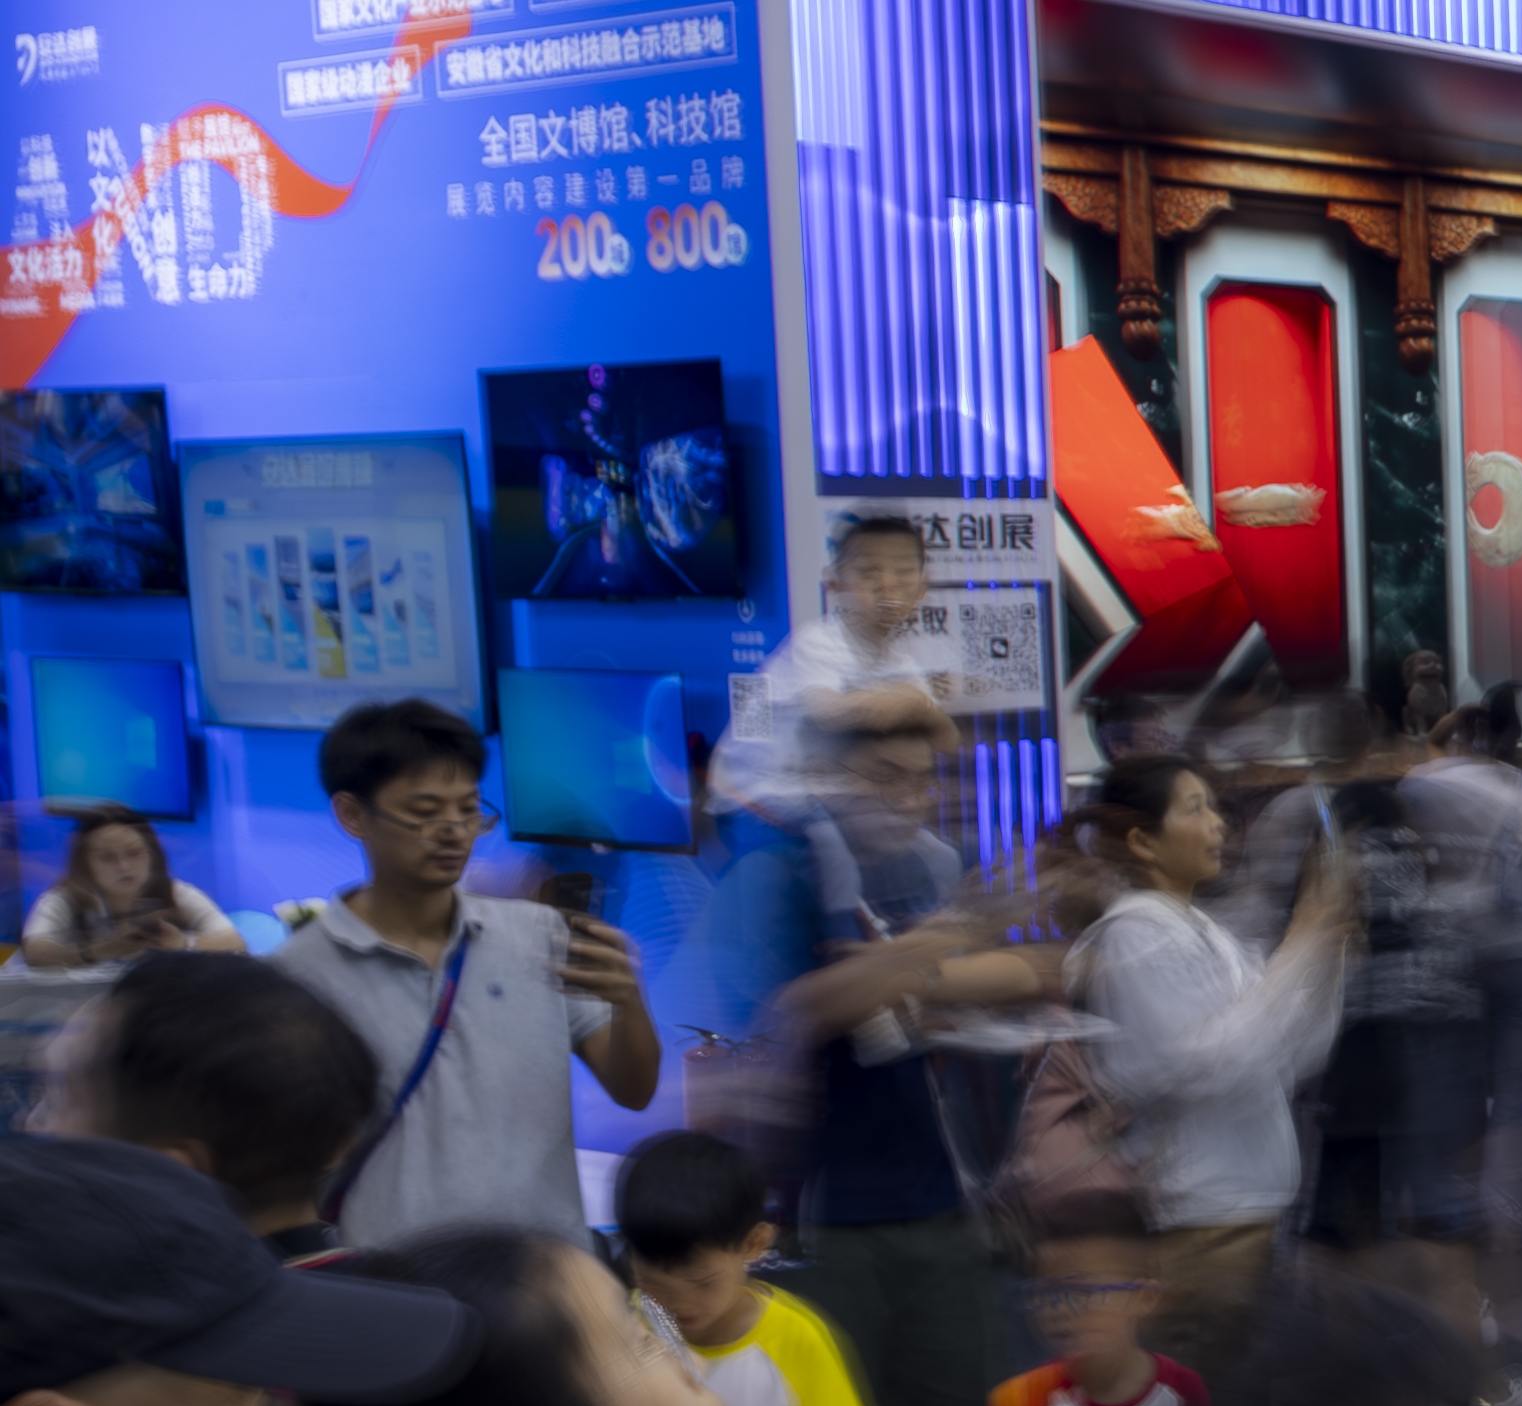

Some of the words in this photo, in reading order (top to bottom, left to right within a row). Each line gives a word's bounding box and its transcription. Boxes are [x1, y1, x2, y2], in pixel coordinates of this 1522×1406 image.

[478, 88, 745, 168] 全国文博馆、科技馆
[910, 513, 1035, 550] 达创展
